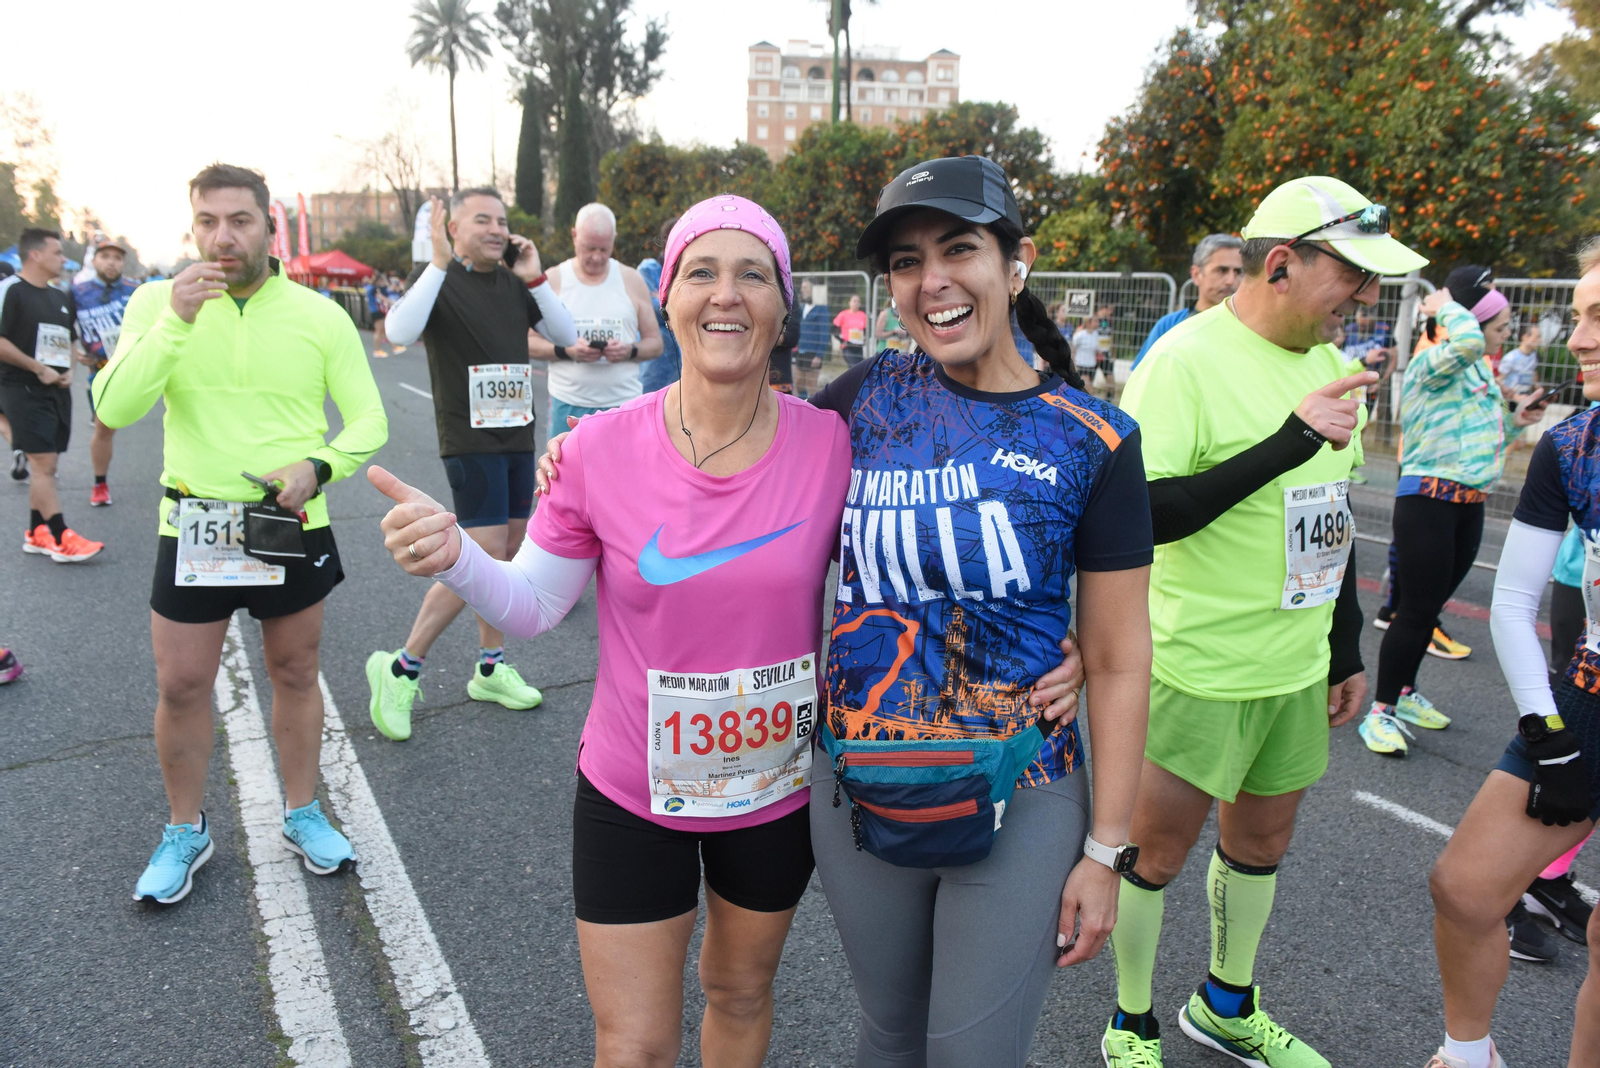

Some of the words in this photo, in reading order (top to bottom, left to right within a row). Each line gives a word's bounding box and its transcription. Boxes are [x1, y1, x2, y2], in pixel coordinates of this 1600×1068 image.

[476, 380, 524, 399] 13937
[990, 448, 1057, 486] HOKA
[862, 458, 979, 506] MARATÓN
[188, 520, 245, 546] 1513
[837, 500, 1031, 603] EVILLA
[659, 675, 686, 690] MEDIO
[688, 675, 730, 693] MARATÓN
[753, 662, 795, 690] SEVILLA
[664, 701, 793, 755] 13839
[723, 755, 740, 763] Ines
[737, 767, 755, 777] Pérez
[726, 799, 751, 809] HOKA
[1213, 879, 1227, 969] compression
